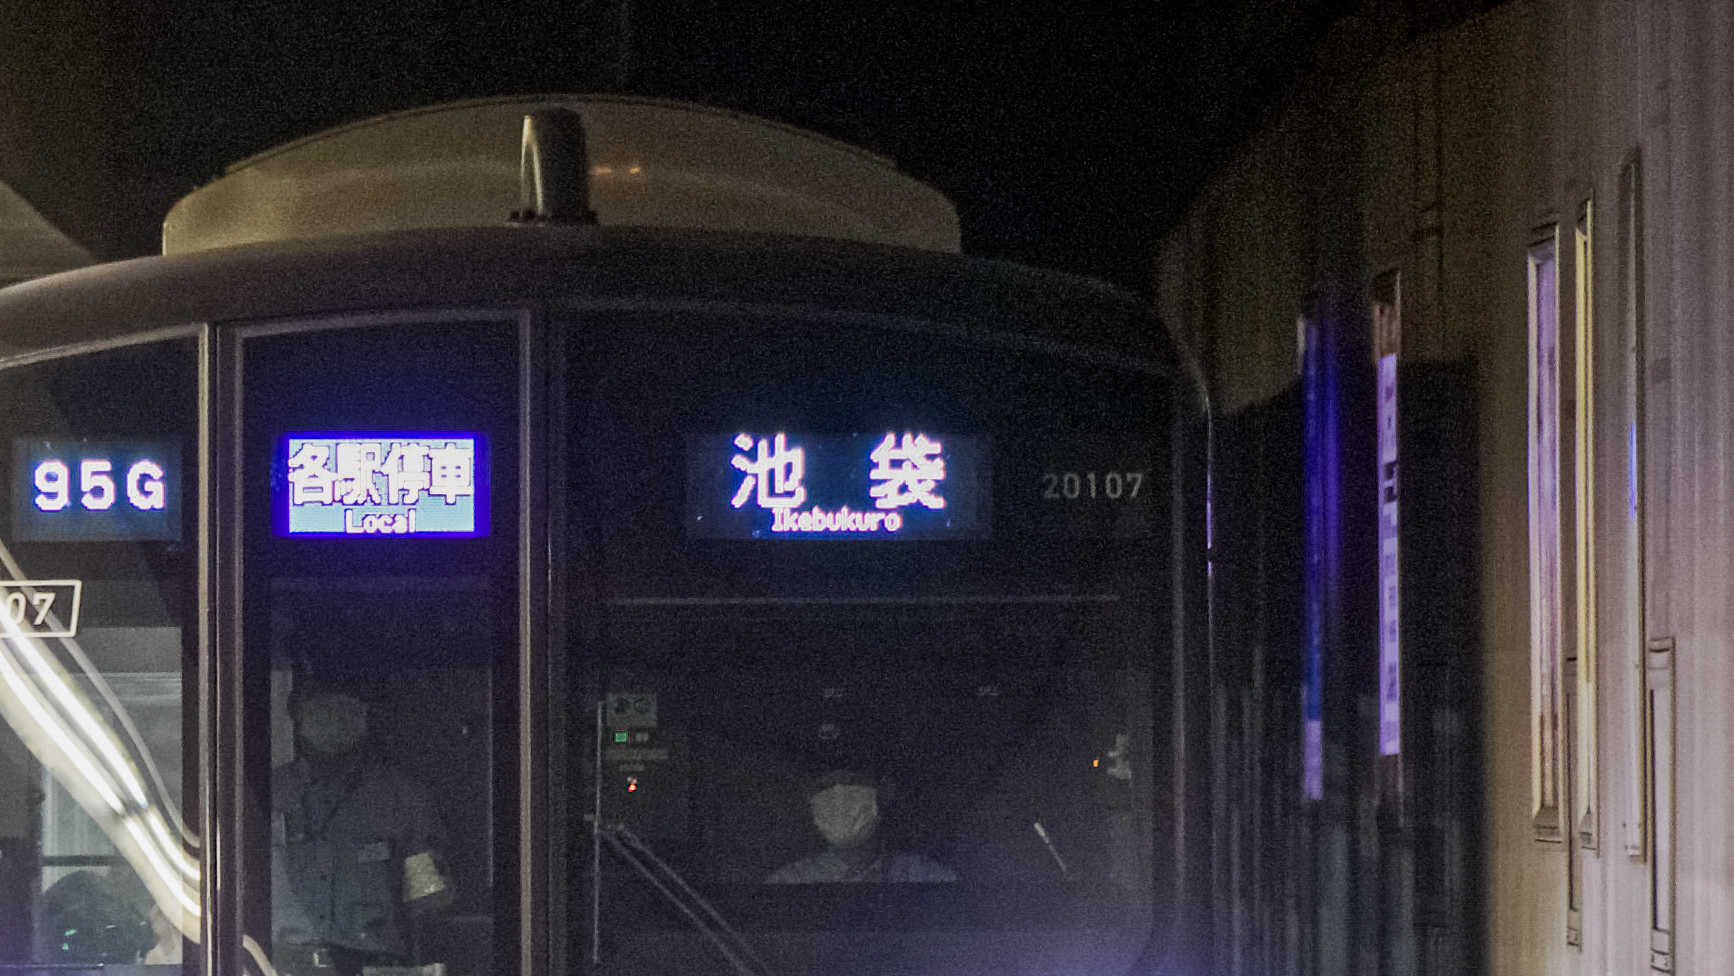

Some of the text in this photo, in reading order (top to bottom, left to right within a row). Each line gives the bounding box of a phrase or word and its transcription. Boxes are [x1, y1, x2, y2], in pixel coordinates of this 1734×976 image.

[34, 459, 165, 511] 95G
[288, 442, 474, 506] 各駅停車
[730, 432, 946, 510] 池袋
[1043, 472, 1144, 499] 20107
[344, 508, 416, 534] Local
[770, 505, 903, 533] Ikebukuro
